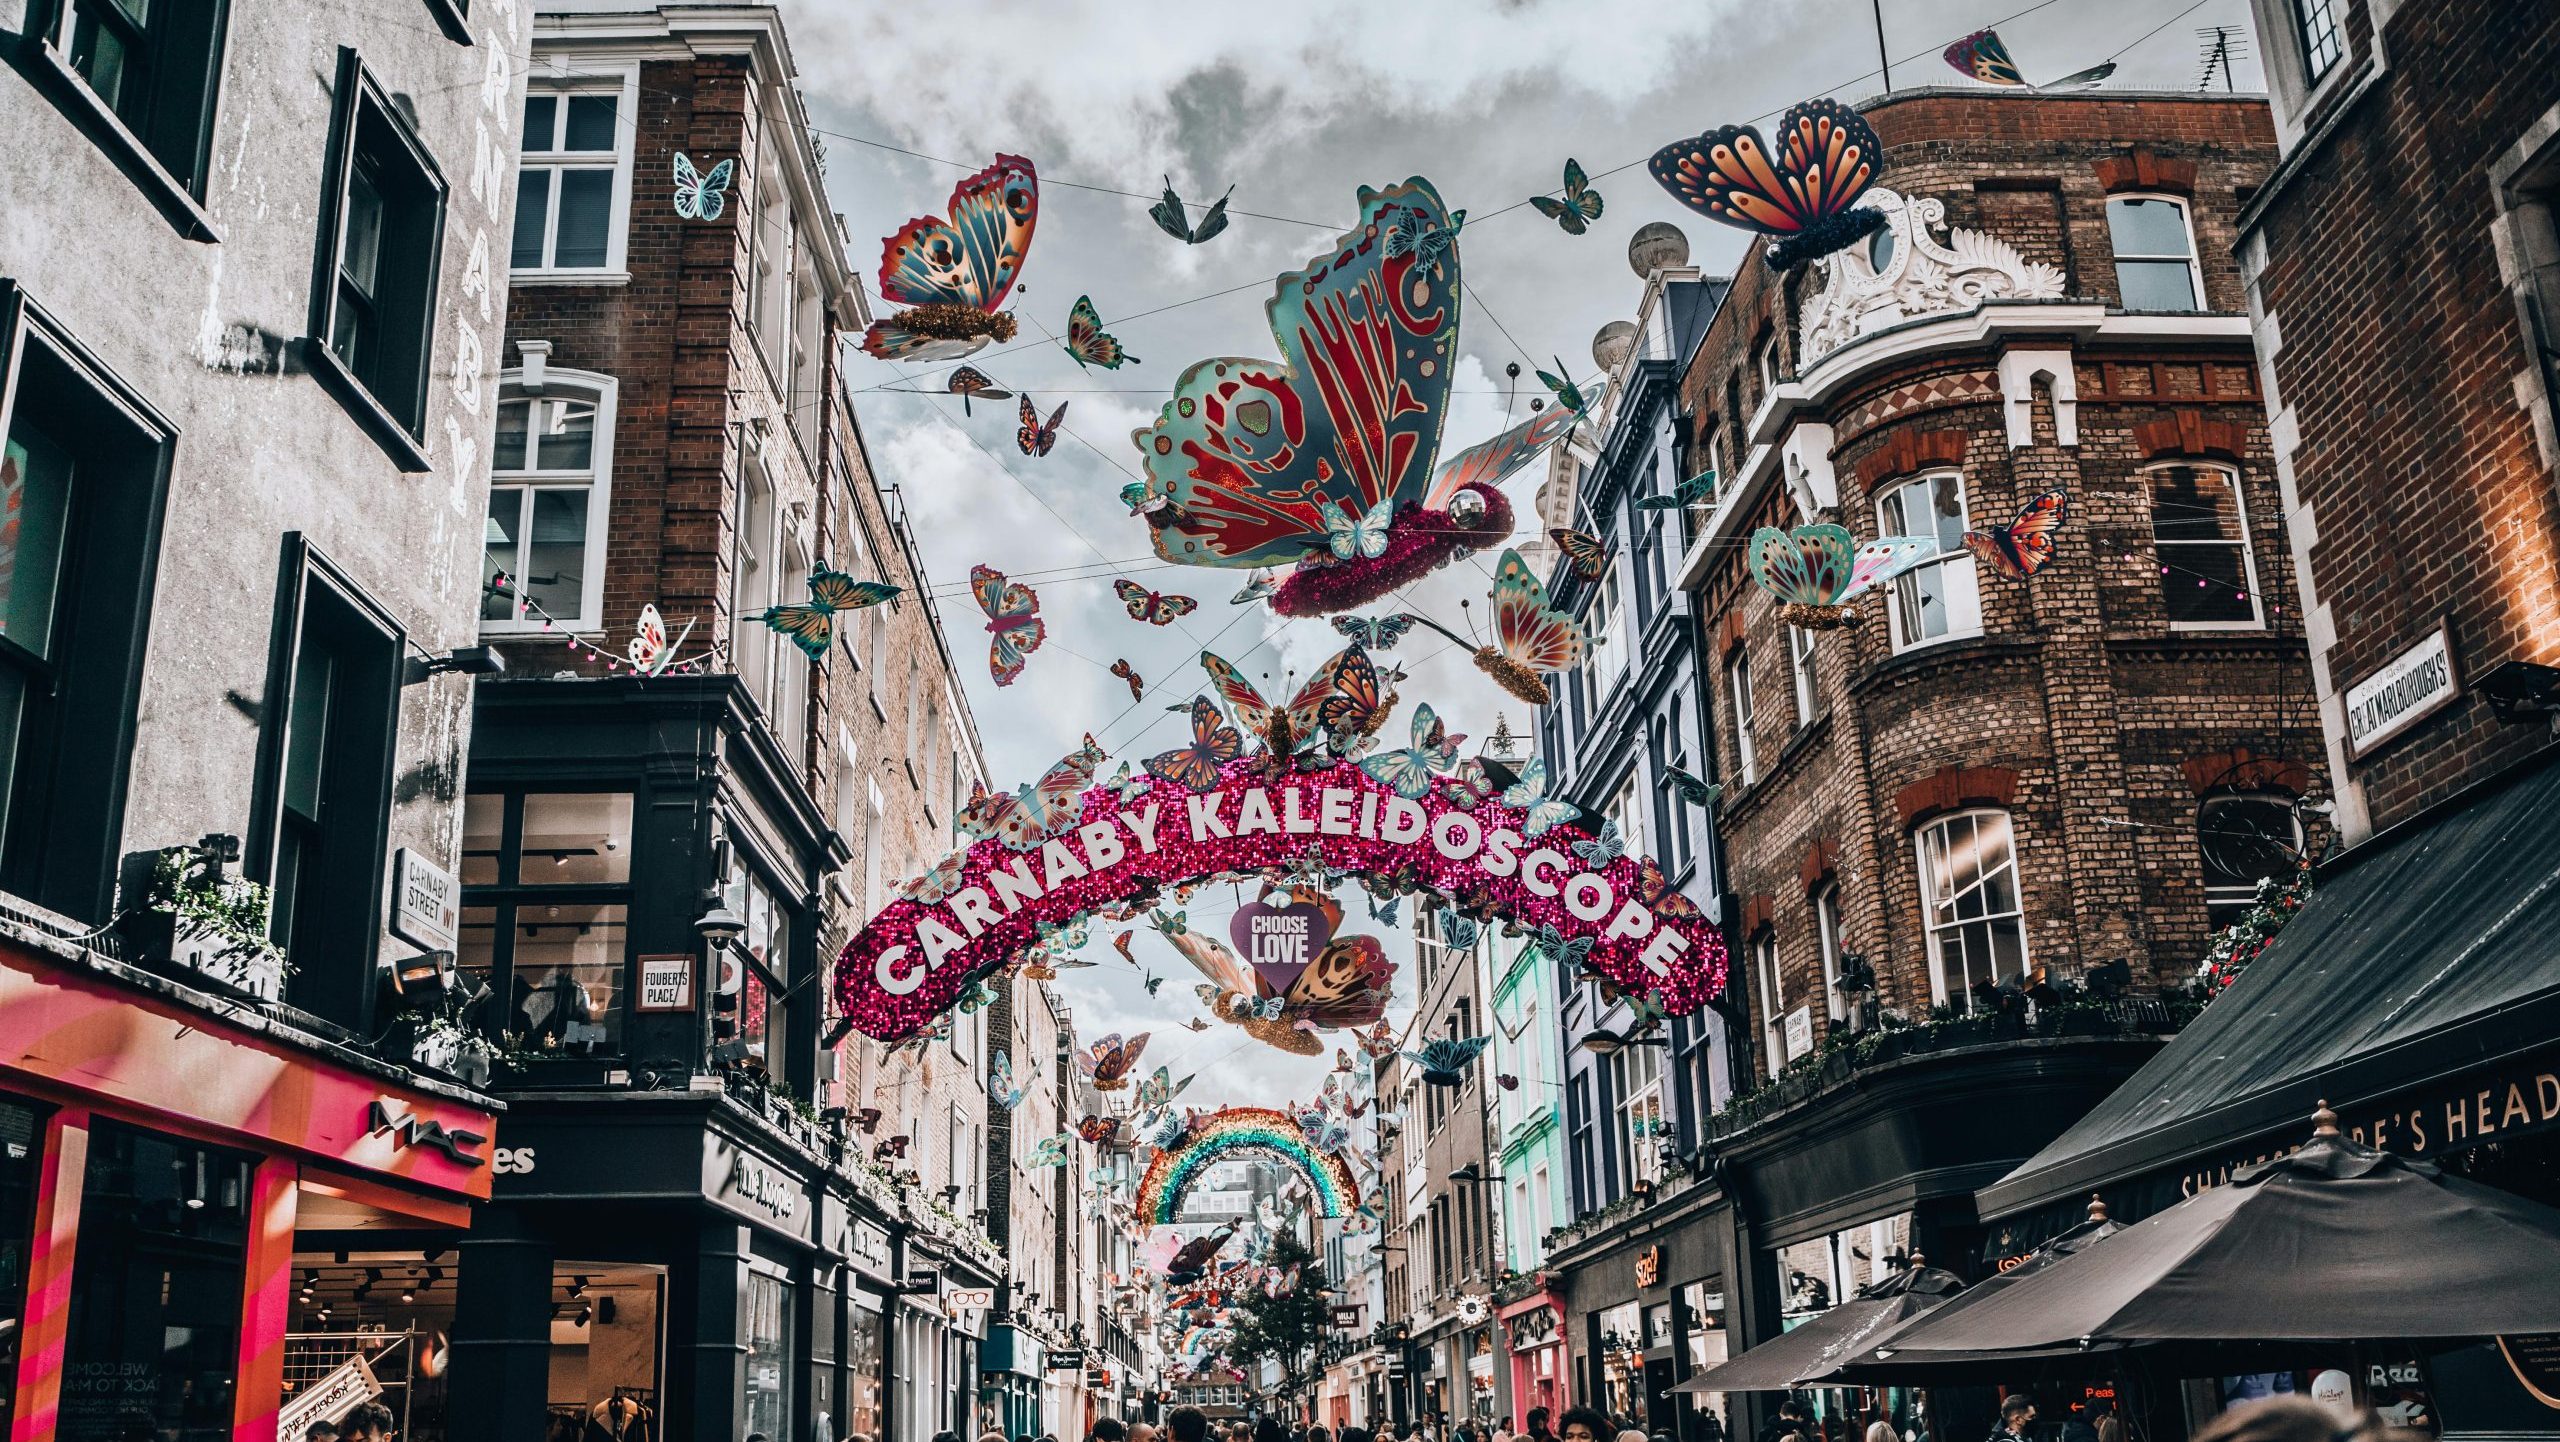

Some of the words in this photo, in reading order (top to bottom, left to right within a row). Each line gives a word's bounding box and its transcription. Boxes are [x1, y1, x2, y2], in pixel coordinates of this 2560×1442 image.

[2375, 656, 2440, 727] MARLBOROUGH
[409, 861, 449, 902] CARNABY
[875, 803, 1160, 996] CARNABY
[1187, 787, 1691, 979] KALEIDOSCOPE
[408, 886, 440, 921] STREET
[443, 906, 455, 931] W1
[1251, 915, 1308, 934] CHOOSE
[1251, 933, 1309, 964] LOVE
[647, 988, 675, 1003] PLACE
[2445, 1073, 2560, 1143] HEAD
[736, 1157, 760, 1200] The
[756, 1169, 795, 1219] Kooples
[1635, 1244, 1658, 1289] size?
[1336, 1311, 1356, 1321] MUJI
